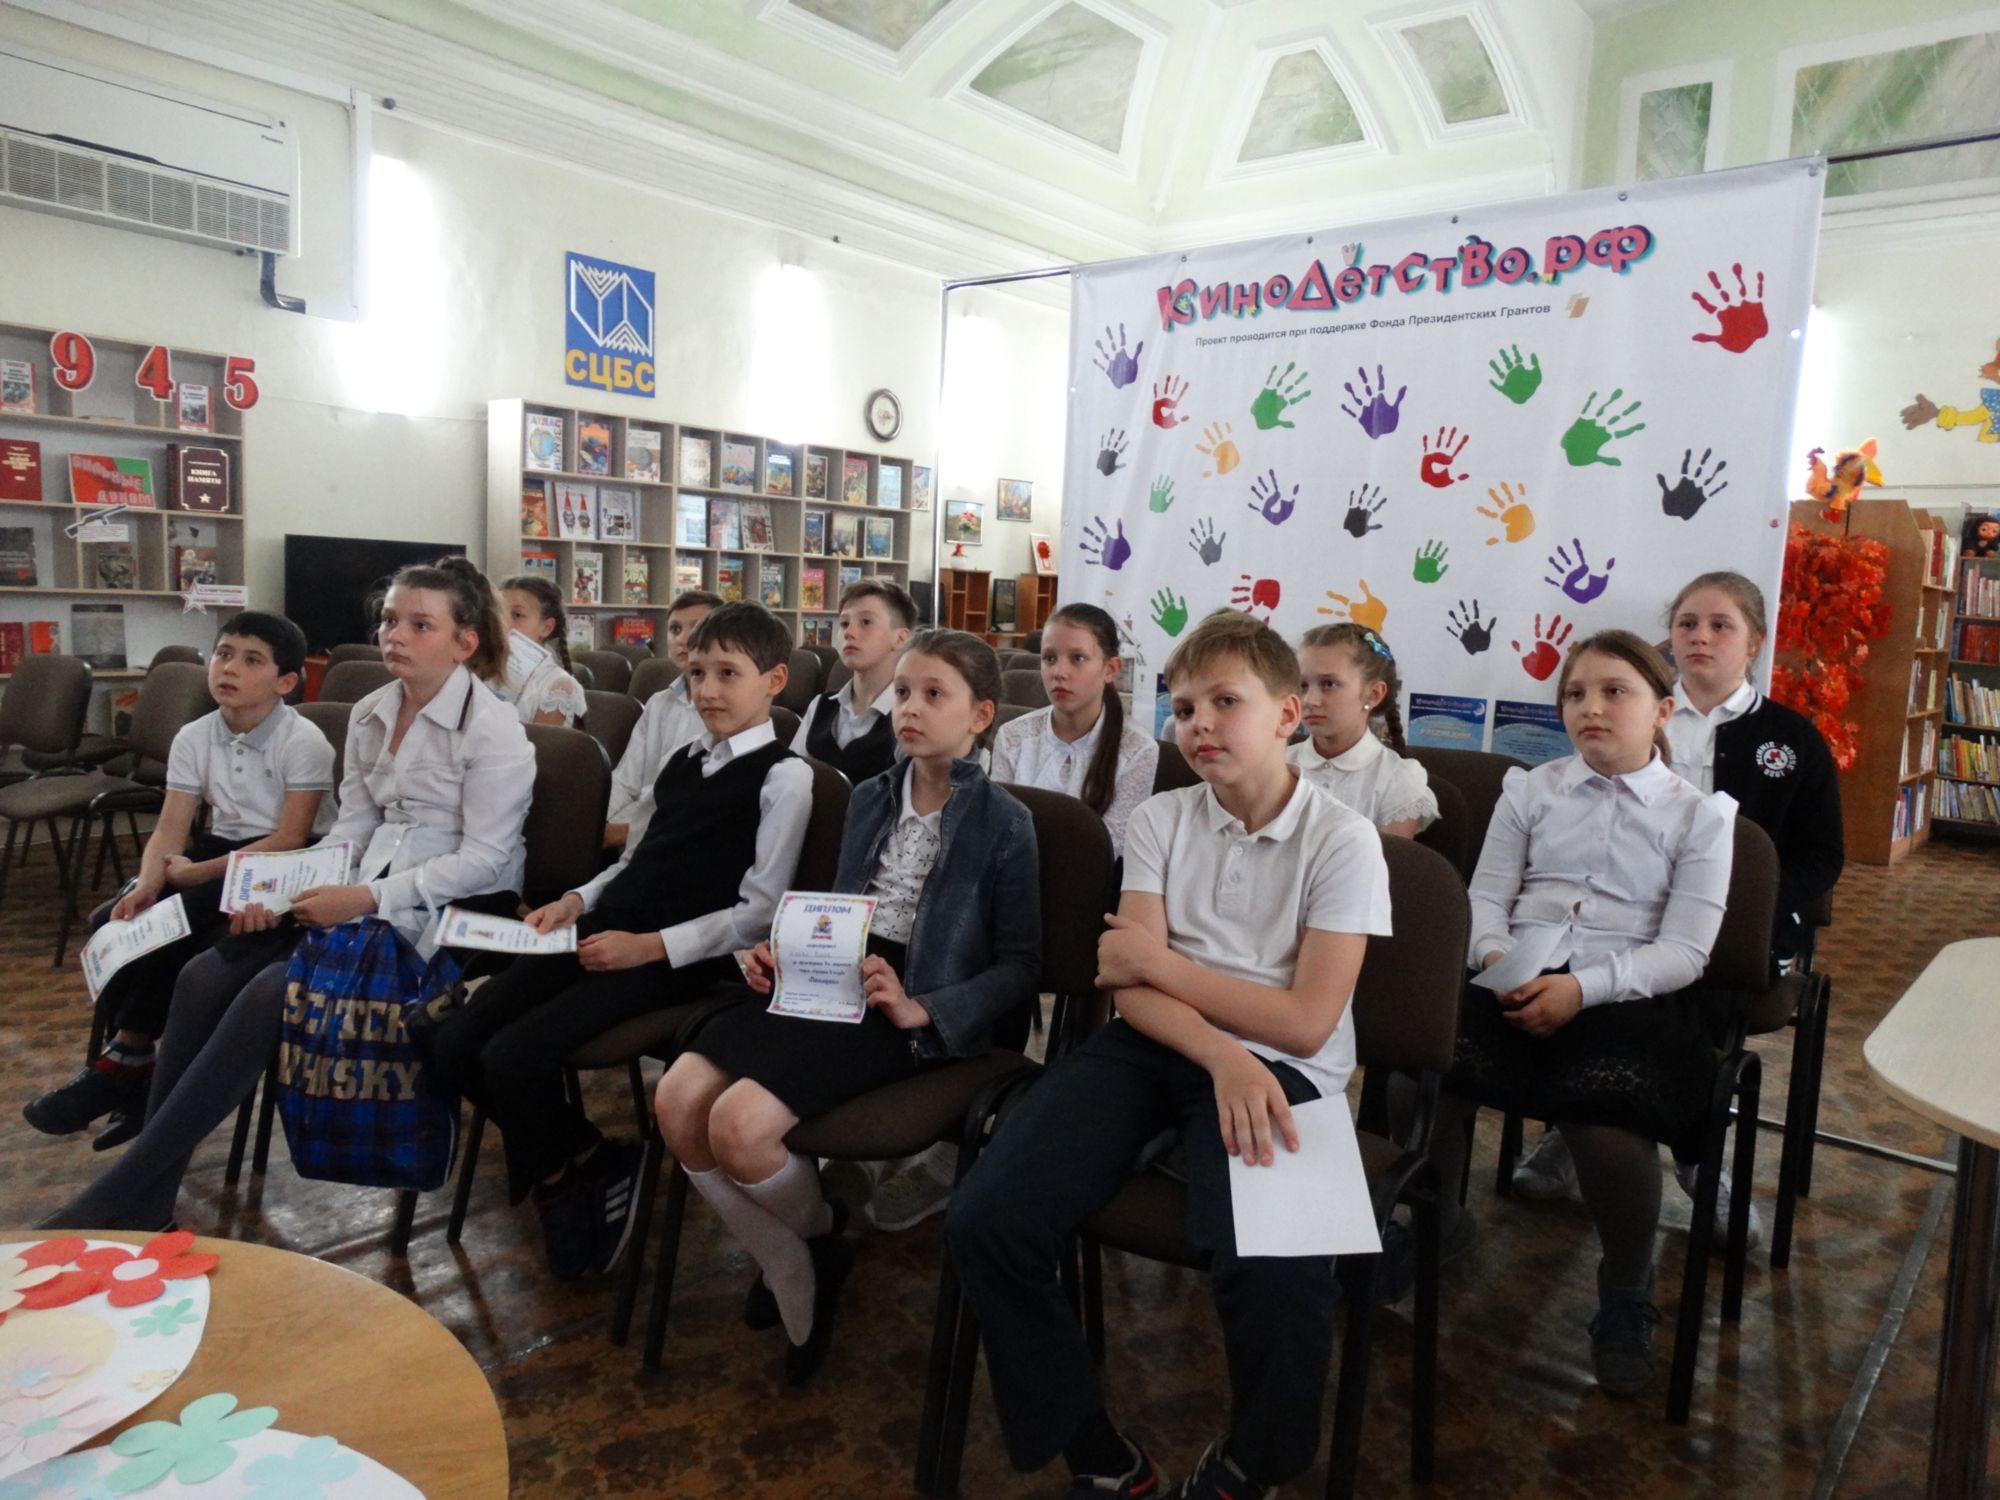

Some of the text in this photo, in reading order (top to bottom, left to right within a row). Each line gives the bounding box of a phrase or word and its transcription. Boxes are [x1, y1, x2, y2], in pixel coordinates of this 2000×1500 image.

[1196, 304, 1551, 347] Проект проводится при поддержке Фонда Президентских Грантов
[566, 349, 655, 392] СЦБС
[190, 469, 217, 477] КНИГА
[187, 476, 222, 485] ПАМЯТИ
[804, 904, 852, 915] ДИПЛОМ
